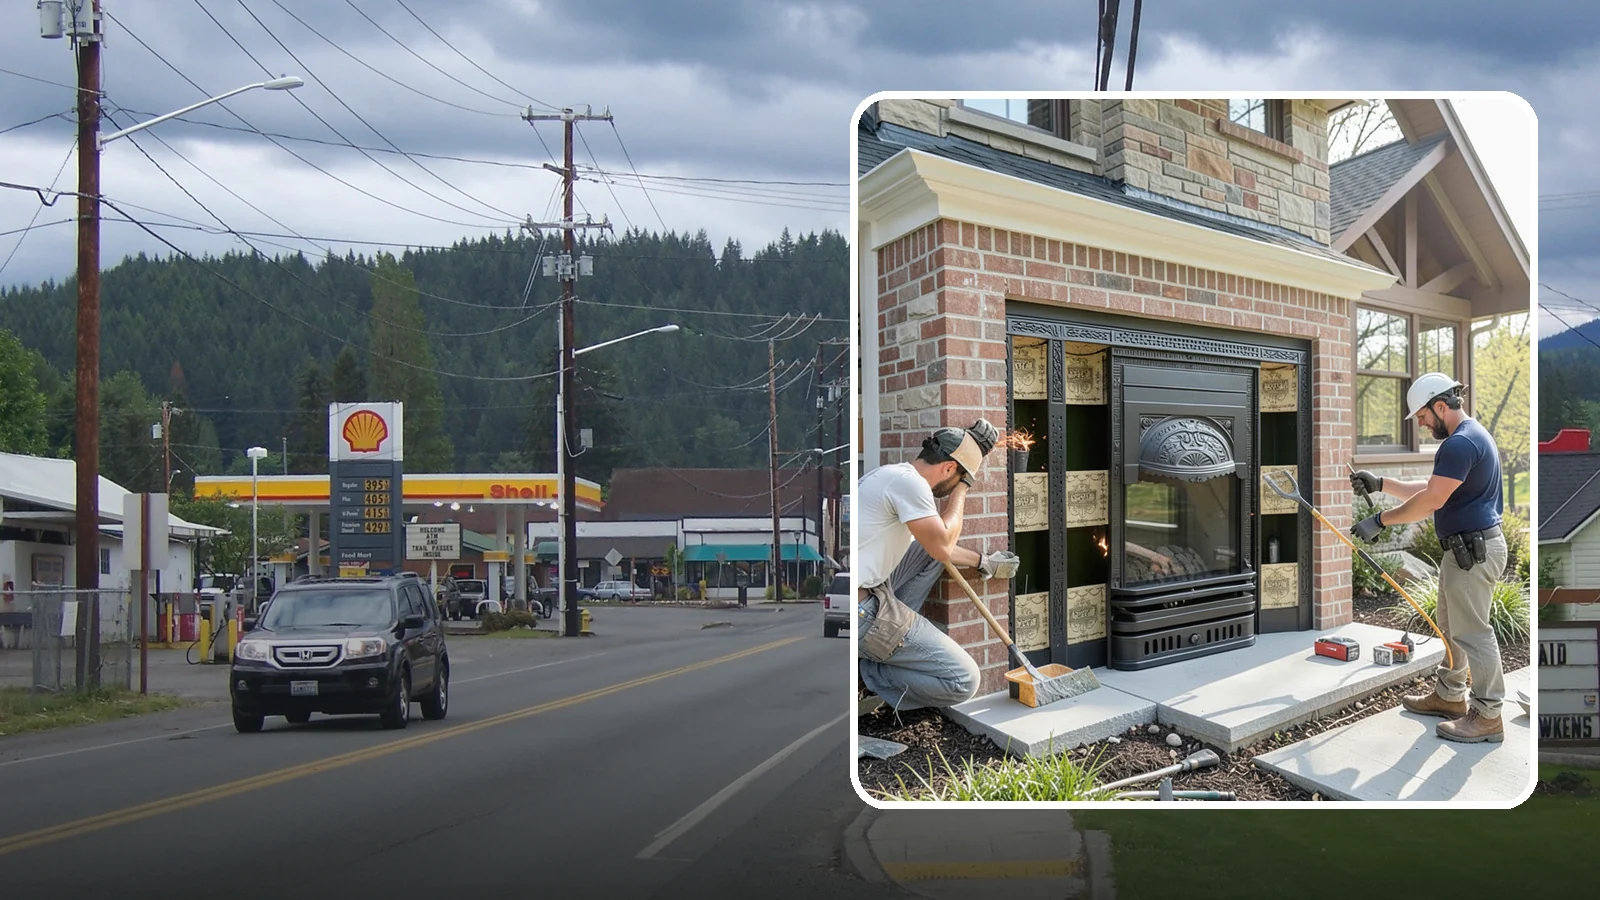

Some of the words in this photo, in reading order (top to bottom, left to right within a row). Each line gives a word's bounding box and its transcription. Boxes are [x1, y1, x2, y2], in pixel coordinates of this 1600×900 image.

[365, 480, 383, 490] 395
[490, 484, 547, 499] Shell
[365, 494, 383, 504] 405
[365, 508, 383, 518] 415
[365, 522, 383, 532] 429
